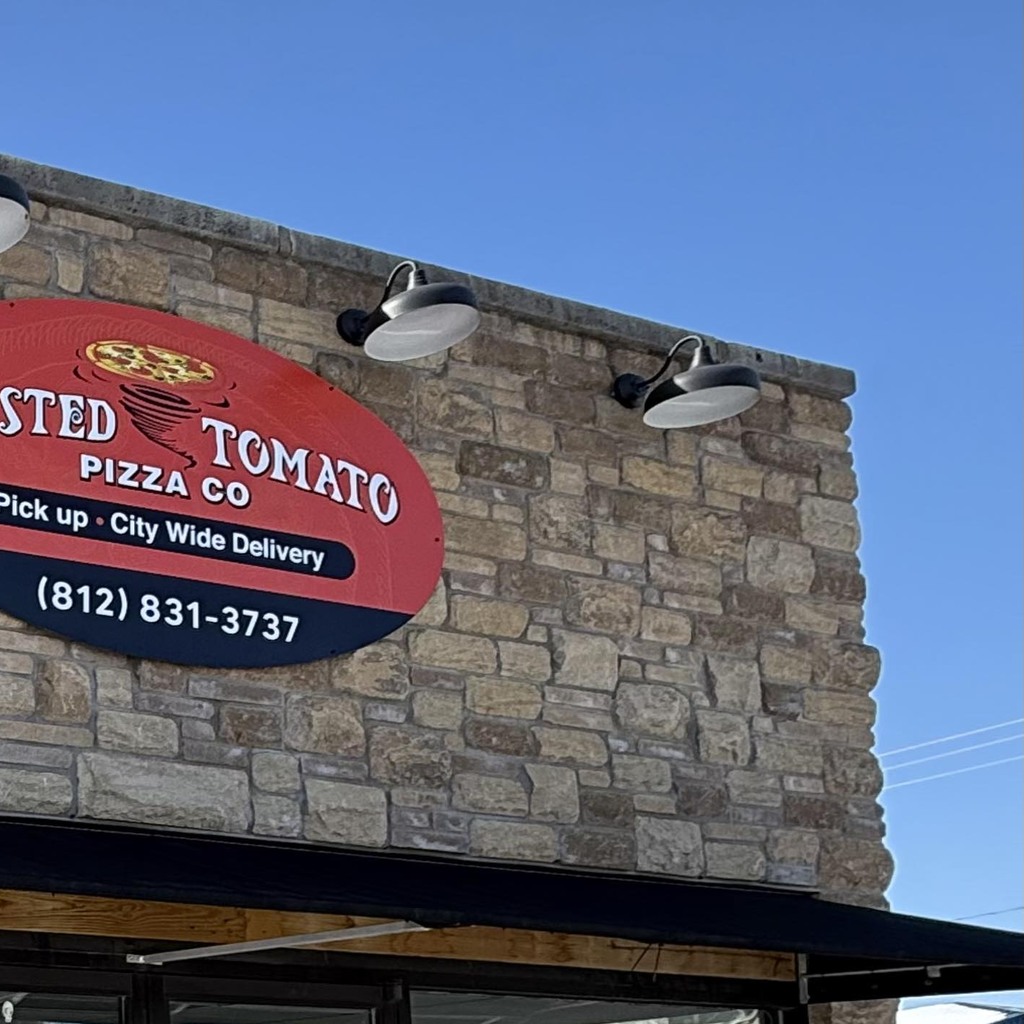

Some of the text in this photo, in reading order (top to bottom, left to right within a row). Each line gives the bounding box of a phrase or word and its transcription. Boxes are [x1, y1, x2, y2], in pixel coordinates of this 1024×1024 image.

[80, 453, 251, 507] PIZZA CO
[201, 416, 399, 524] TOMATO
[56, 506, 89, 532] up
[110, 511, 159, 544] City
[165, 520, 226, 551] Wide
[232, 532, 325, 572] Delivery
[37, 575, 299, 643] (812) 831-3737
